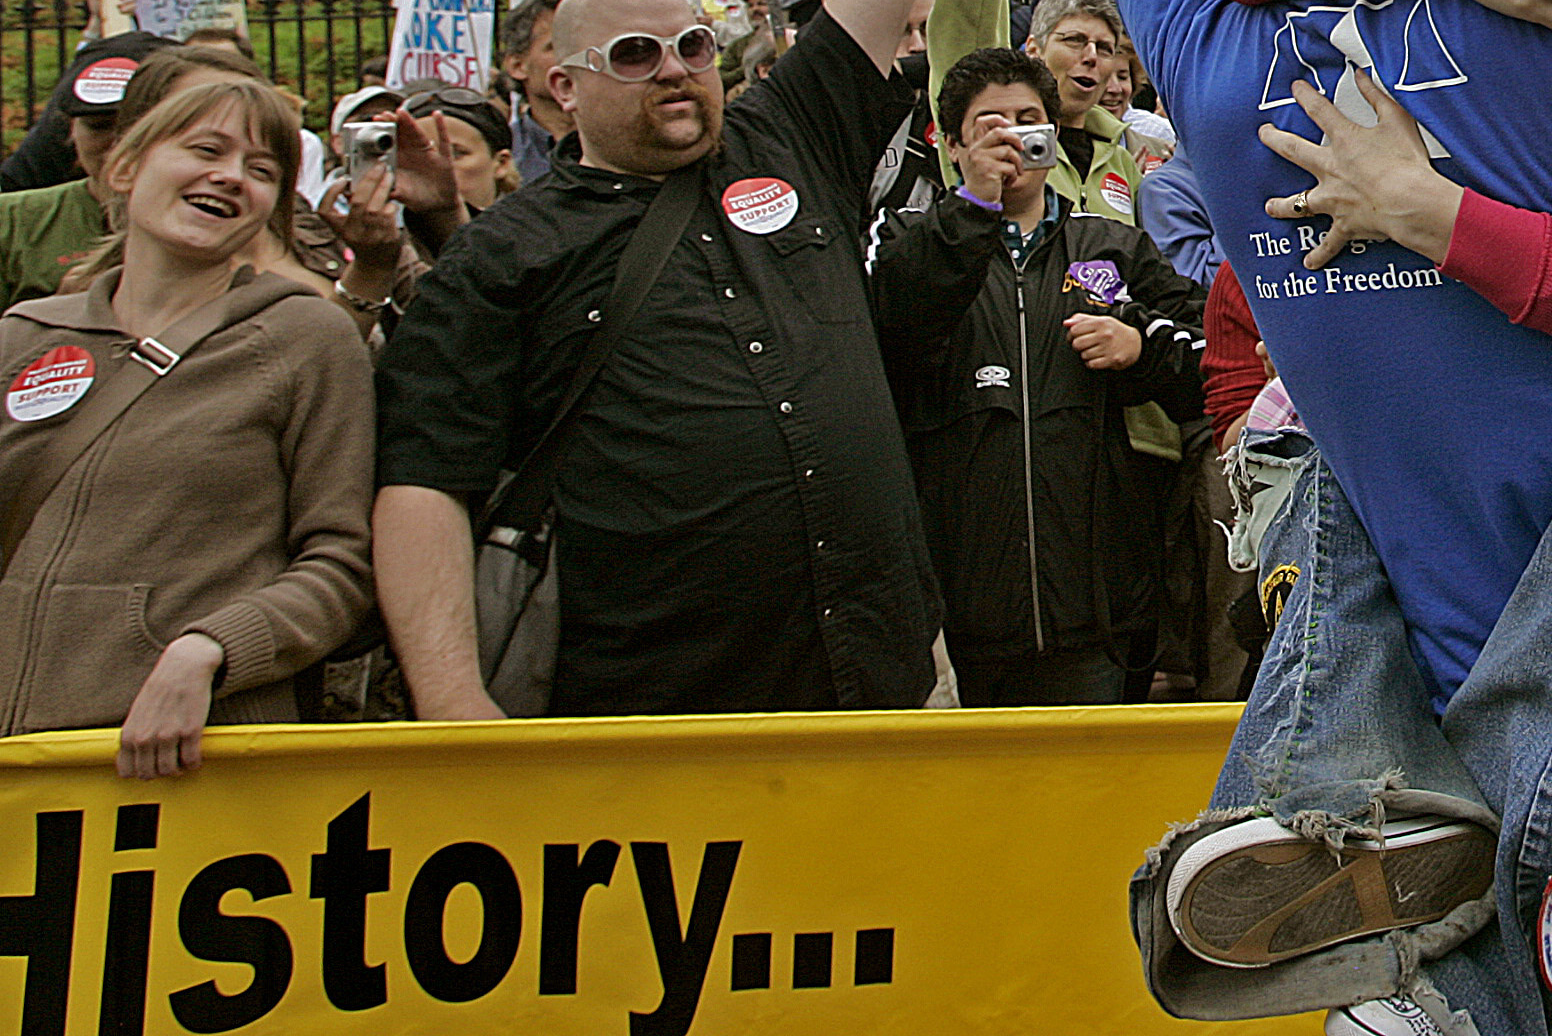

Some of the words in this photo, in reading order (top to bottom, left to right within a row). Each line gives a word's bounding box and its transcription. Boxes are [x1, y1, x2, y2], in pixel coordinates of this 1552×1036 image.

[731, 186, 782, 210] EQUALITY
[740, 197, 790, 222] SUPPORT
[1250, 232, 1292, 257] The
[1256, 275, 1279, 299] for
[1283, 272, 1317, 298] the
[1324, 263, 1443, 295] Freedom
[23, 365, 87, 387] EQUALITY
[17, 383, 80, 404] SUPPORT
